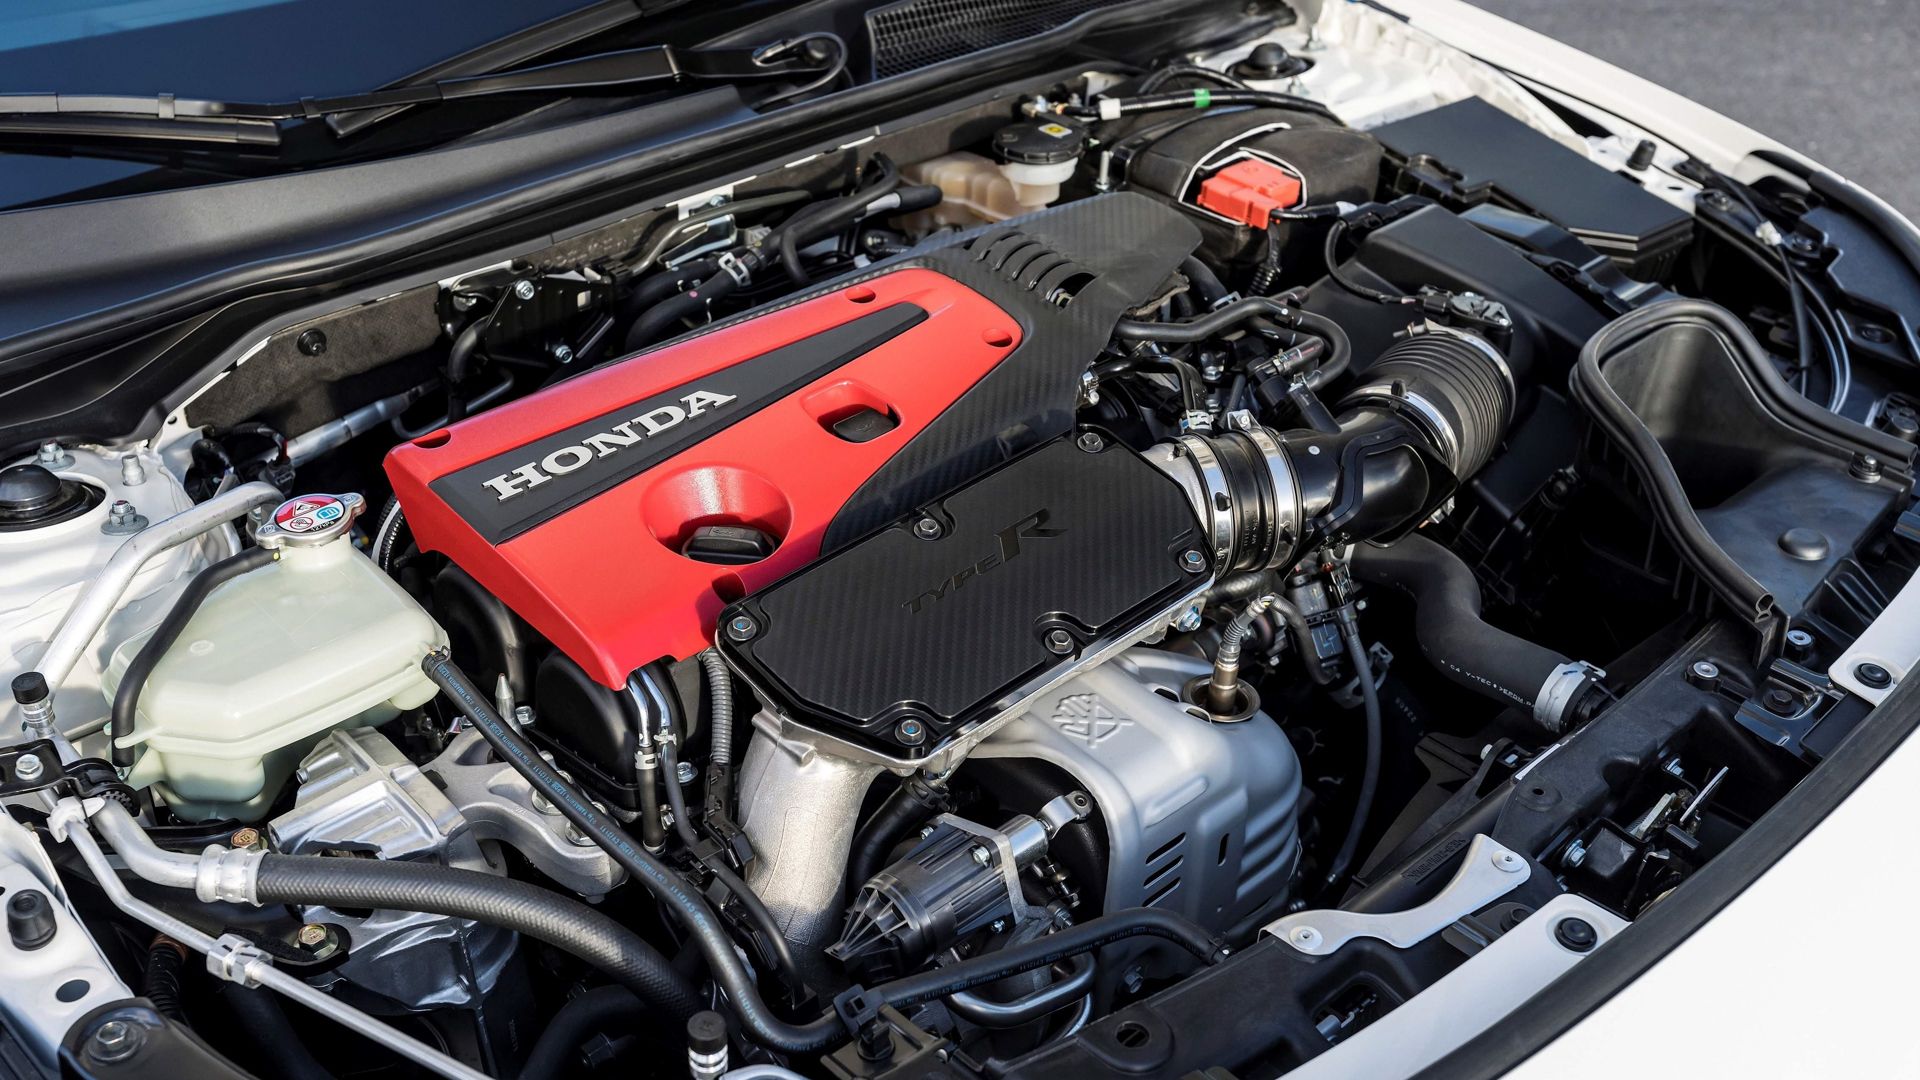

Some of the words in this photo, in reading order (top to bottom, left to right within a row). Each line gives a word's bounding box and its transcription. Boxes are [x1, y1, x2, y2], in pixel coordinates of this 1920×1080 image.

[482, 390, 738, 502] HONDA
[902, 553, 1001, 615] TYPE
[994, 508, 1068, 563] R
